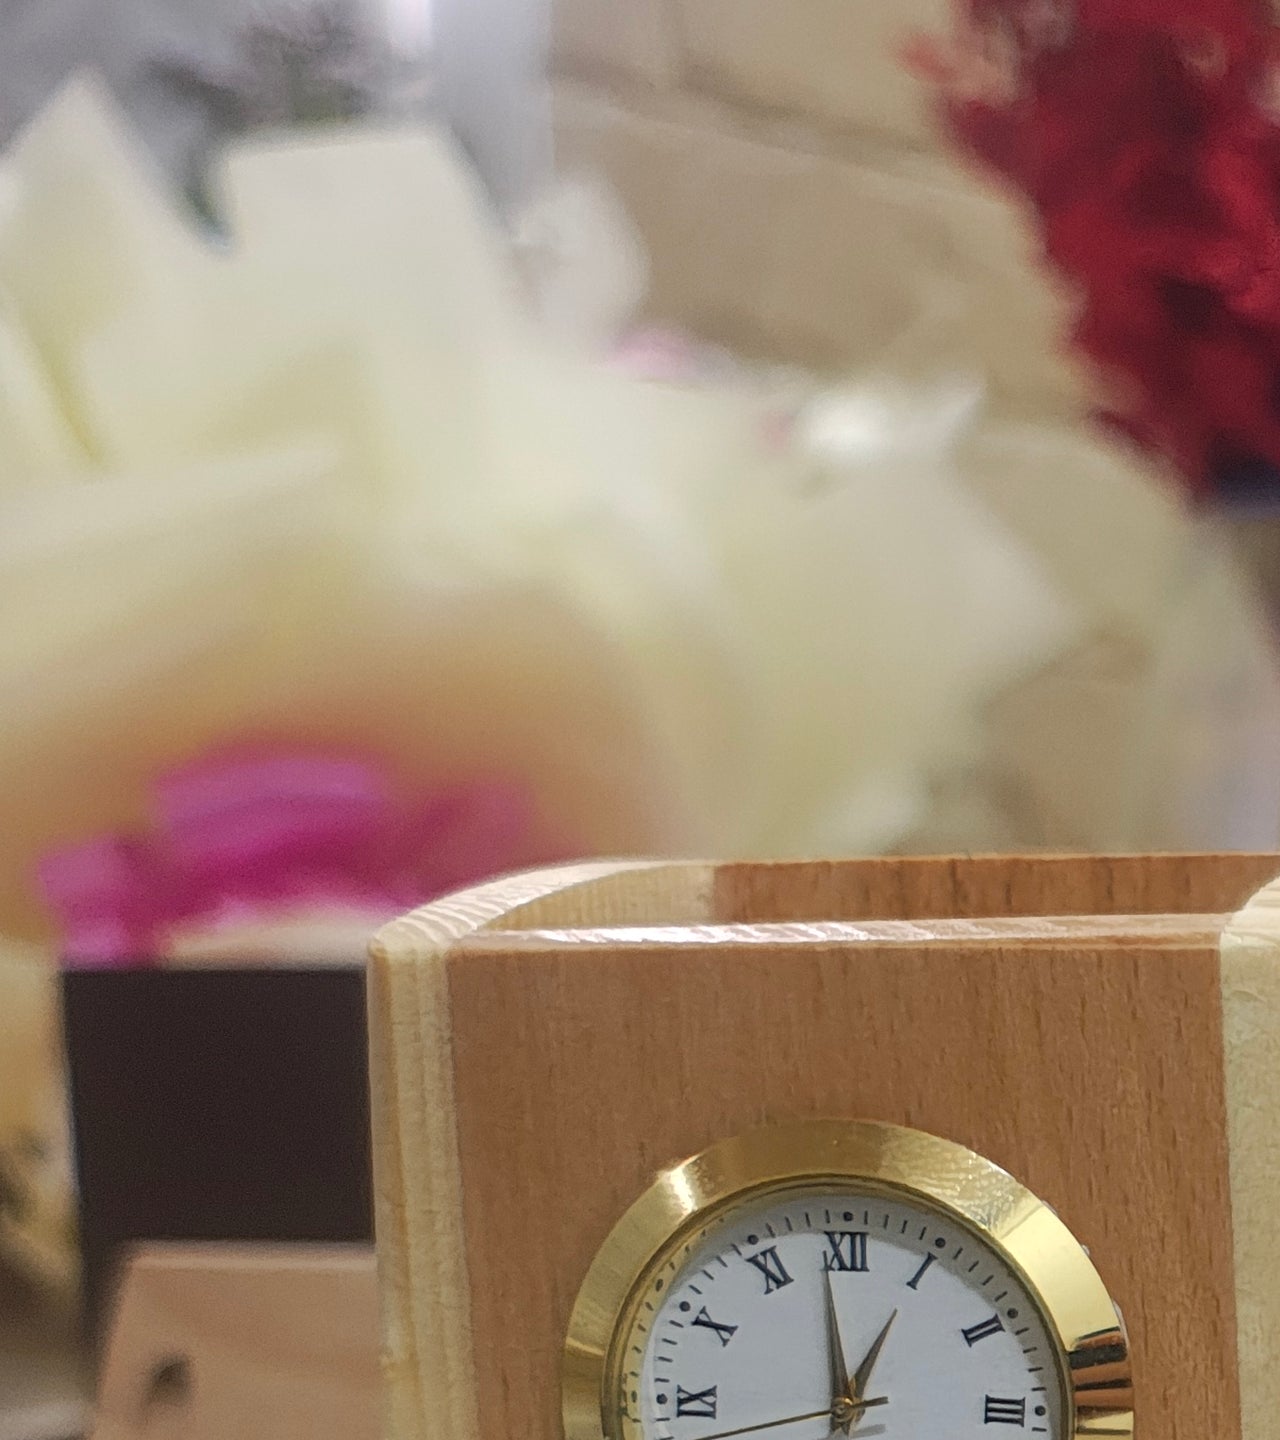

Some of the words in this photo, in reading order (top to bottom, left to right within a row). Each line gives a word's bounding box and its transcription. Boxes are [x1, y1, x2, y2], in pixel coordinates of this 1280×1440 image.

[746, 1246, 794, 1294] XI
[825, 1230, 870, 1273] XII
[906, 1252, 939, 1290] I
[691, 1306, 738, 1347] X
[961, 1312, 1005, 1347] II
[676, 1385, 717, 1419] IX
[984, 1395, 1025, 1427] III
